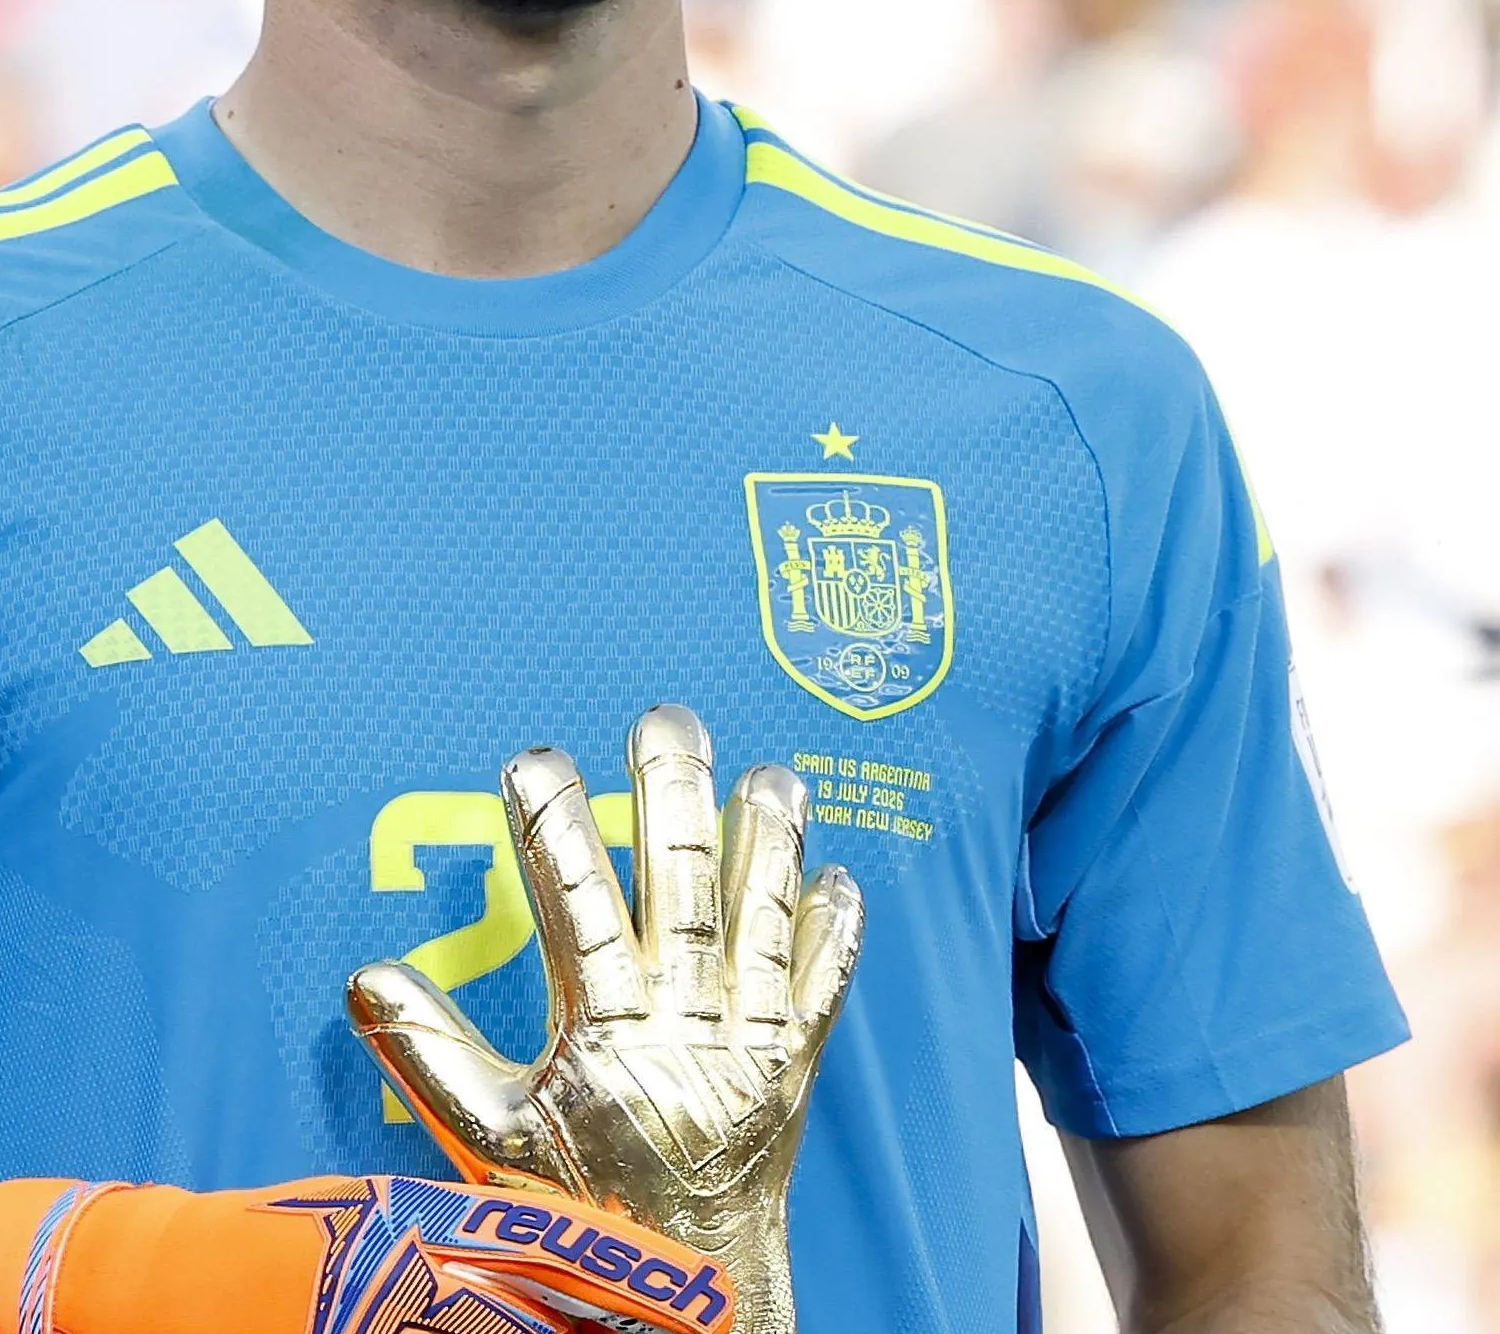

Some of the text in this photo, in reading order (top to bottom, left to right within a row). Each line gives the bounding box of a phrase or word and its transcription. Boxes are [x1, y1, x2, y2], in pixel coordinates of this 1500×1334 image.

[794, 753, 833, 775] SPAIN
[861, 761, 931, 791] ARGENTINA
[818, 780, 905, 811] 19 JULY 2026
[816, 805, 853, 826] YORK
[856, 809, 889, 830] NEW
[892, 815, 933, 841] JERSEY
[462, 1199, 726, 1326] reusch
